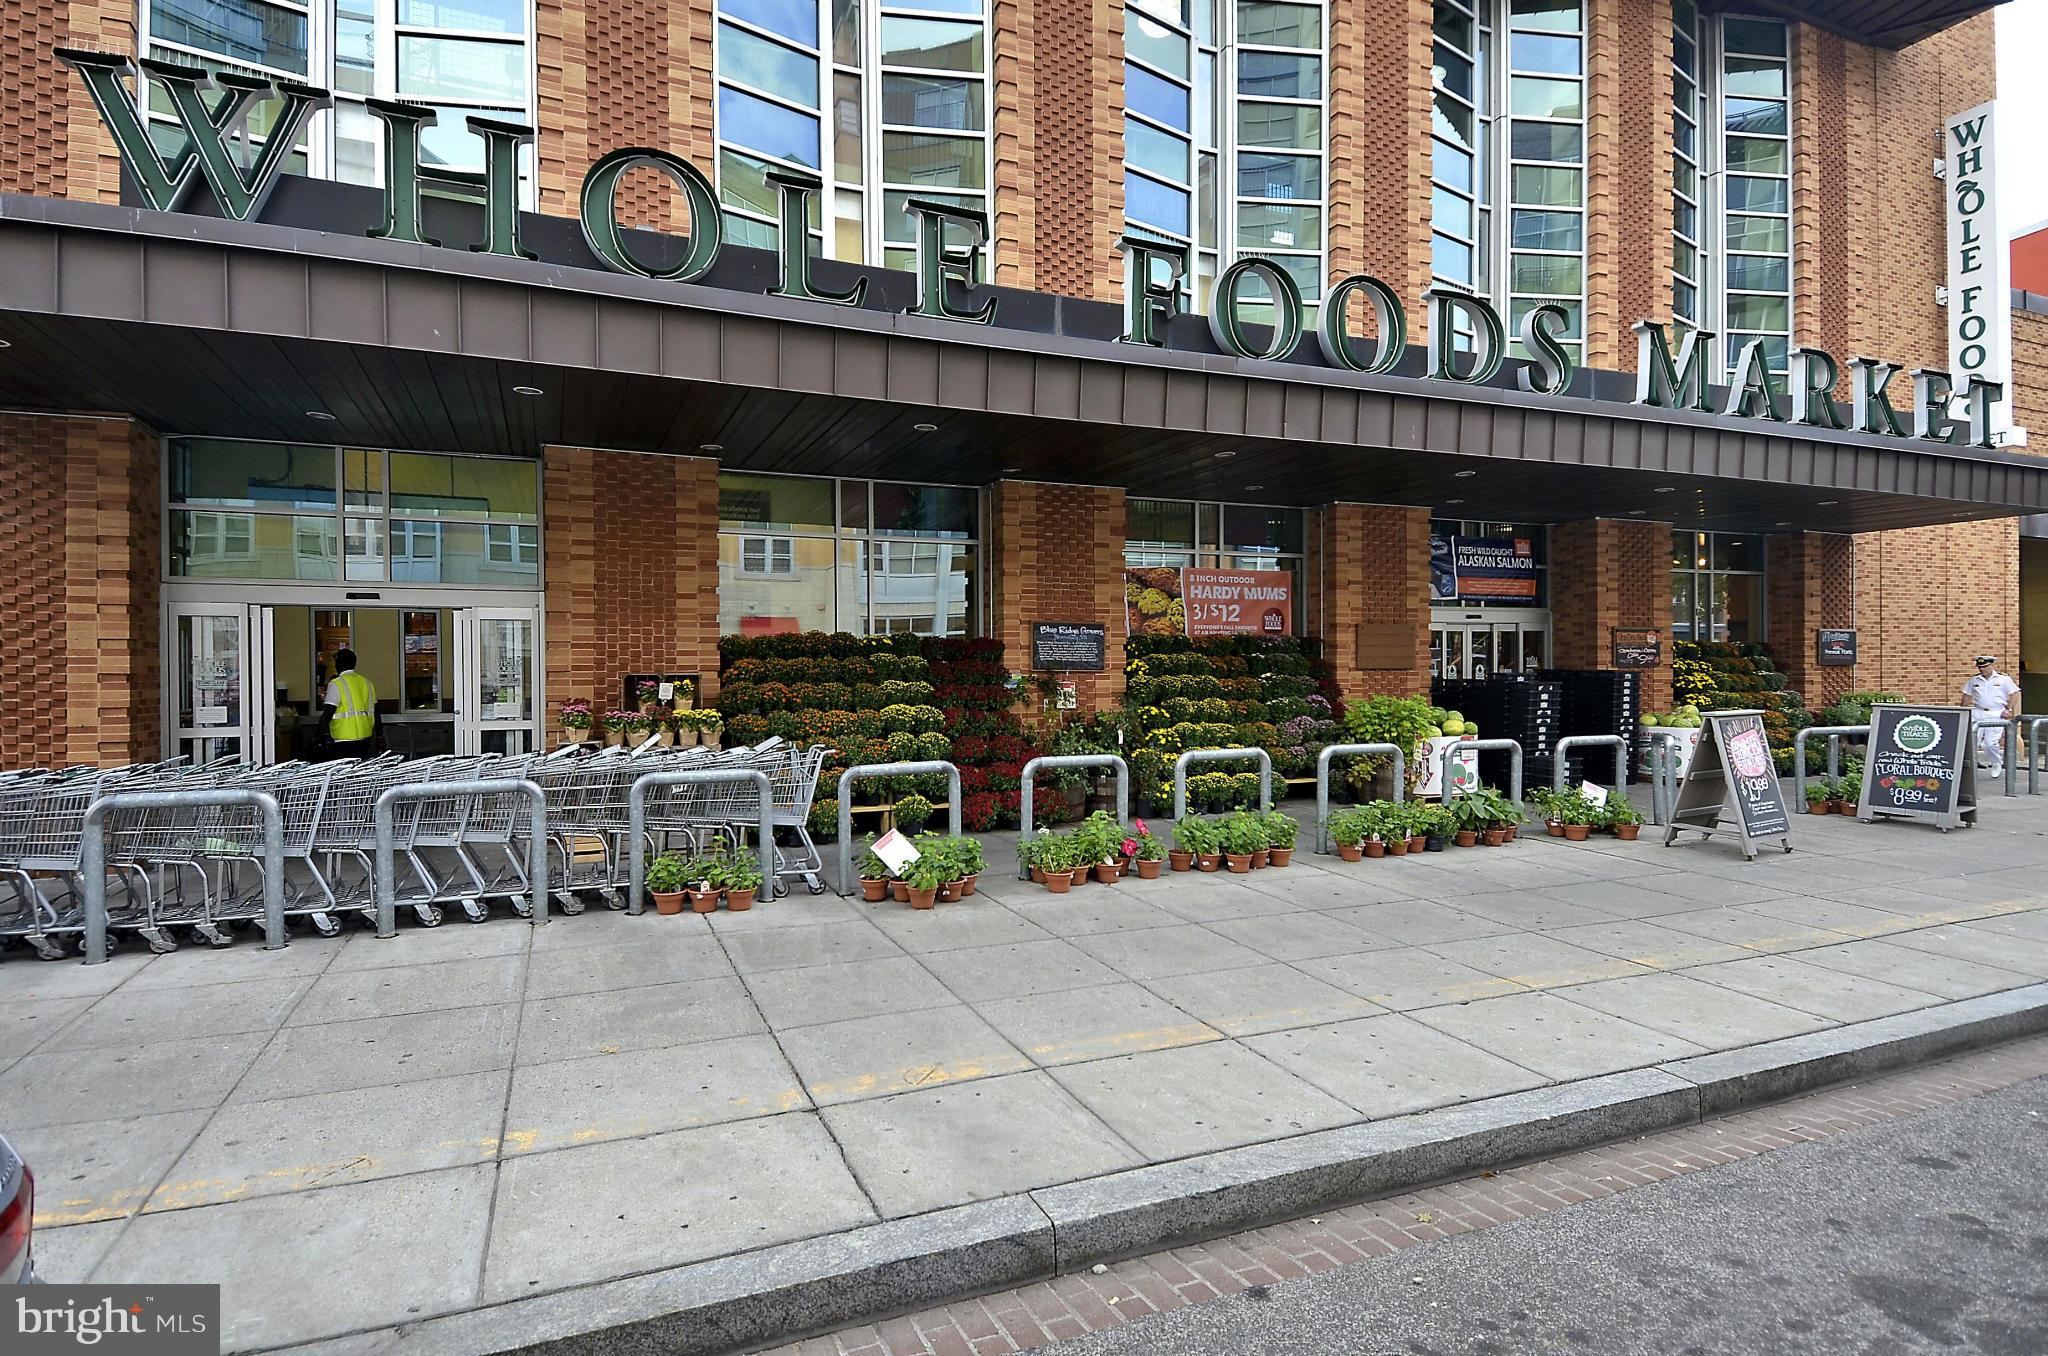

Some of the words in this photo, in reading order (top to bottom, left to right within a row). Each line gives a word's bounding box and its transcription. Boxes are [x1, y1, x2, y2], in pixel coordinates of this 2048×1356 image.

[1951, 114, 1988, 276] WHOLE
[53, 46, 998, 325] WHOLE
[1114, 236, 1573, 396] FOODS
[1631, 320, 2003, 449] MARKET
[1458, 546, 1477, 555] FRESH
[1477, 547, 1491, 556] WILD
[1491, 548, 1513, 557] CAUGHT
[1458, 556, 1496, 568] ALASKAN
[1496, 557, 1533, 569] SALMON
[1218, 576, 1256, 584] OUTDOOR
[1189, 585, 1242, 600] HARDY
[1244, 587, 1288, 601] MUMS
[1040, 625, 1058, 634] Blue
[1058, 626, 1080, 635] Ridge
[1893, 757, 1918, 765] Whole
[1875, 763, 1914, 776] FLORAL
[1914, 764, 1955, 780] BOUQUETS
